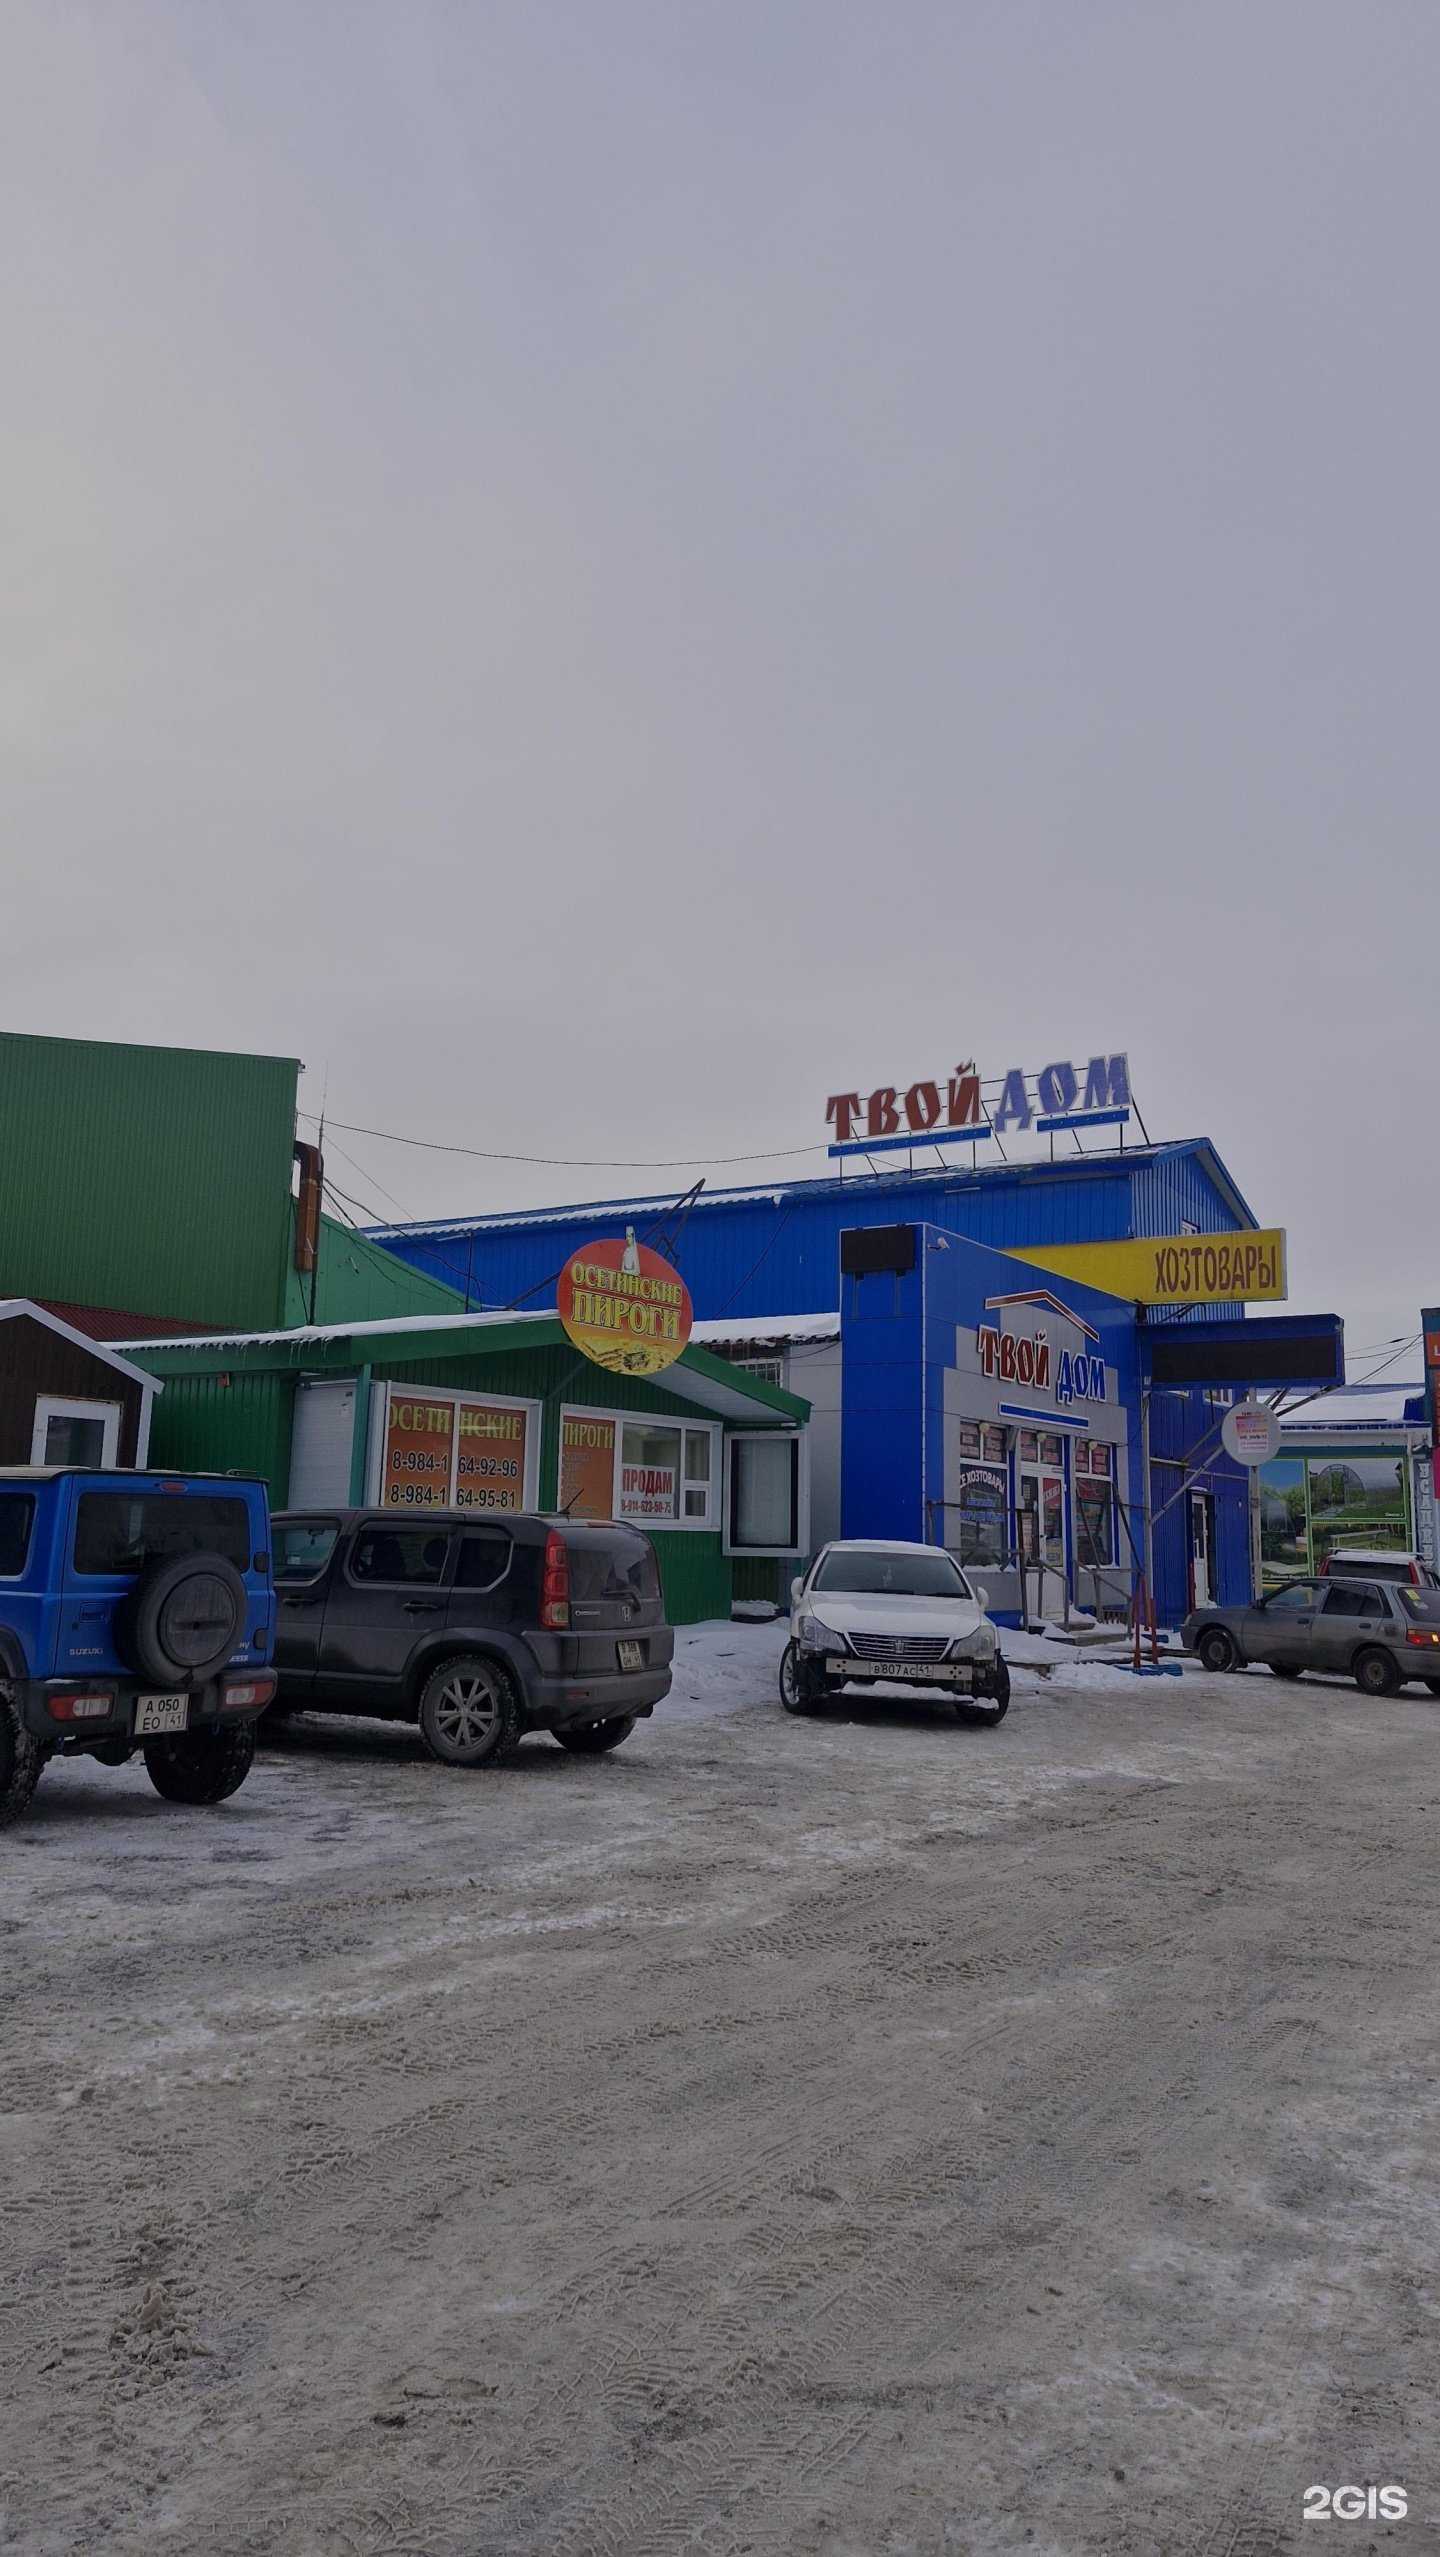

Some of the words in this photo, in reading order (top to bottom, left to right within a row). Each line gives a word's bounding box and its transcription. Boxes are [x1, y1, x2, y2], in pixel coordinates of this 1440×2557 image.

[825, 1056, 980, 1141] ТВОЙ
[993, 1051, 1131, 1133] ДОМ
[570, 1259, 682, 1304] ОСЕТИНСКИЕ
[1155, 1245, 1277, 1293] ХОЗТОВАРЫ
[570, 1287, 681, 1342] ПИРОГИ
[977, 1324, 1050, 1390] ТВОЙ
[1056, 1348, 1106, 1405] ДОМ
[623, 1468, 673, 1497] ПРОДАМ
[967, 1470, 1006, 1496] ХОЗТОВАРЫ
[142, 1717, 160, 1730] ЕО
[170, 1715, 181, 1725] 41
[145, 1701, 153, 1713] А
[158, 1699, 180, 1711] 050
